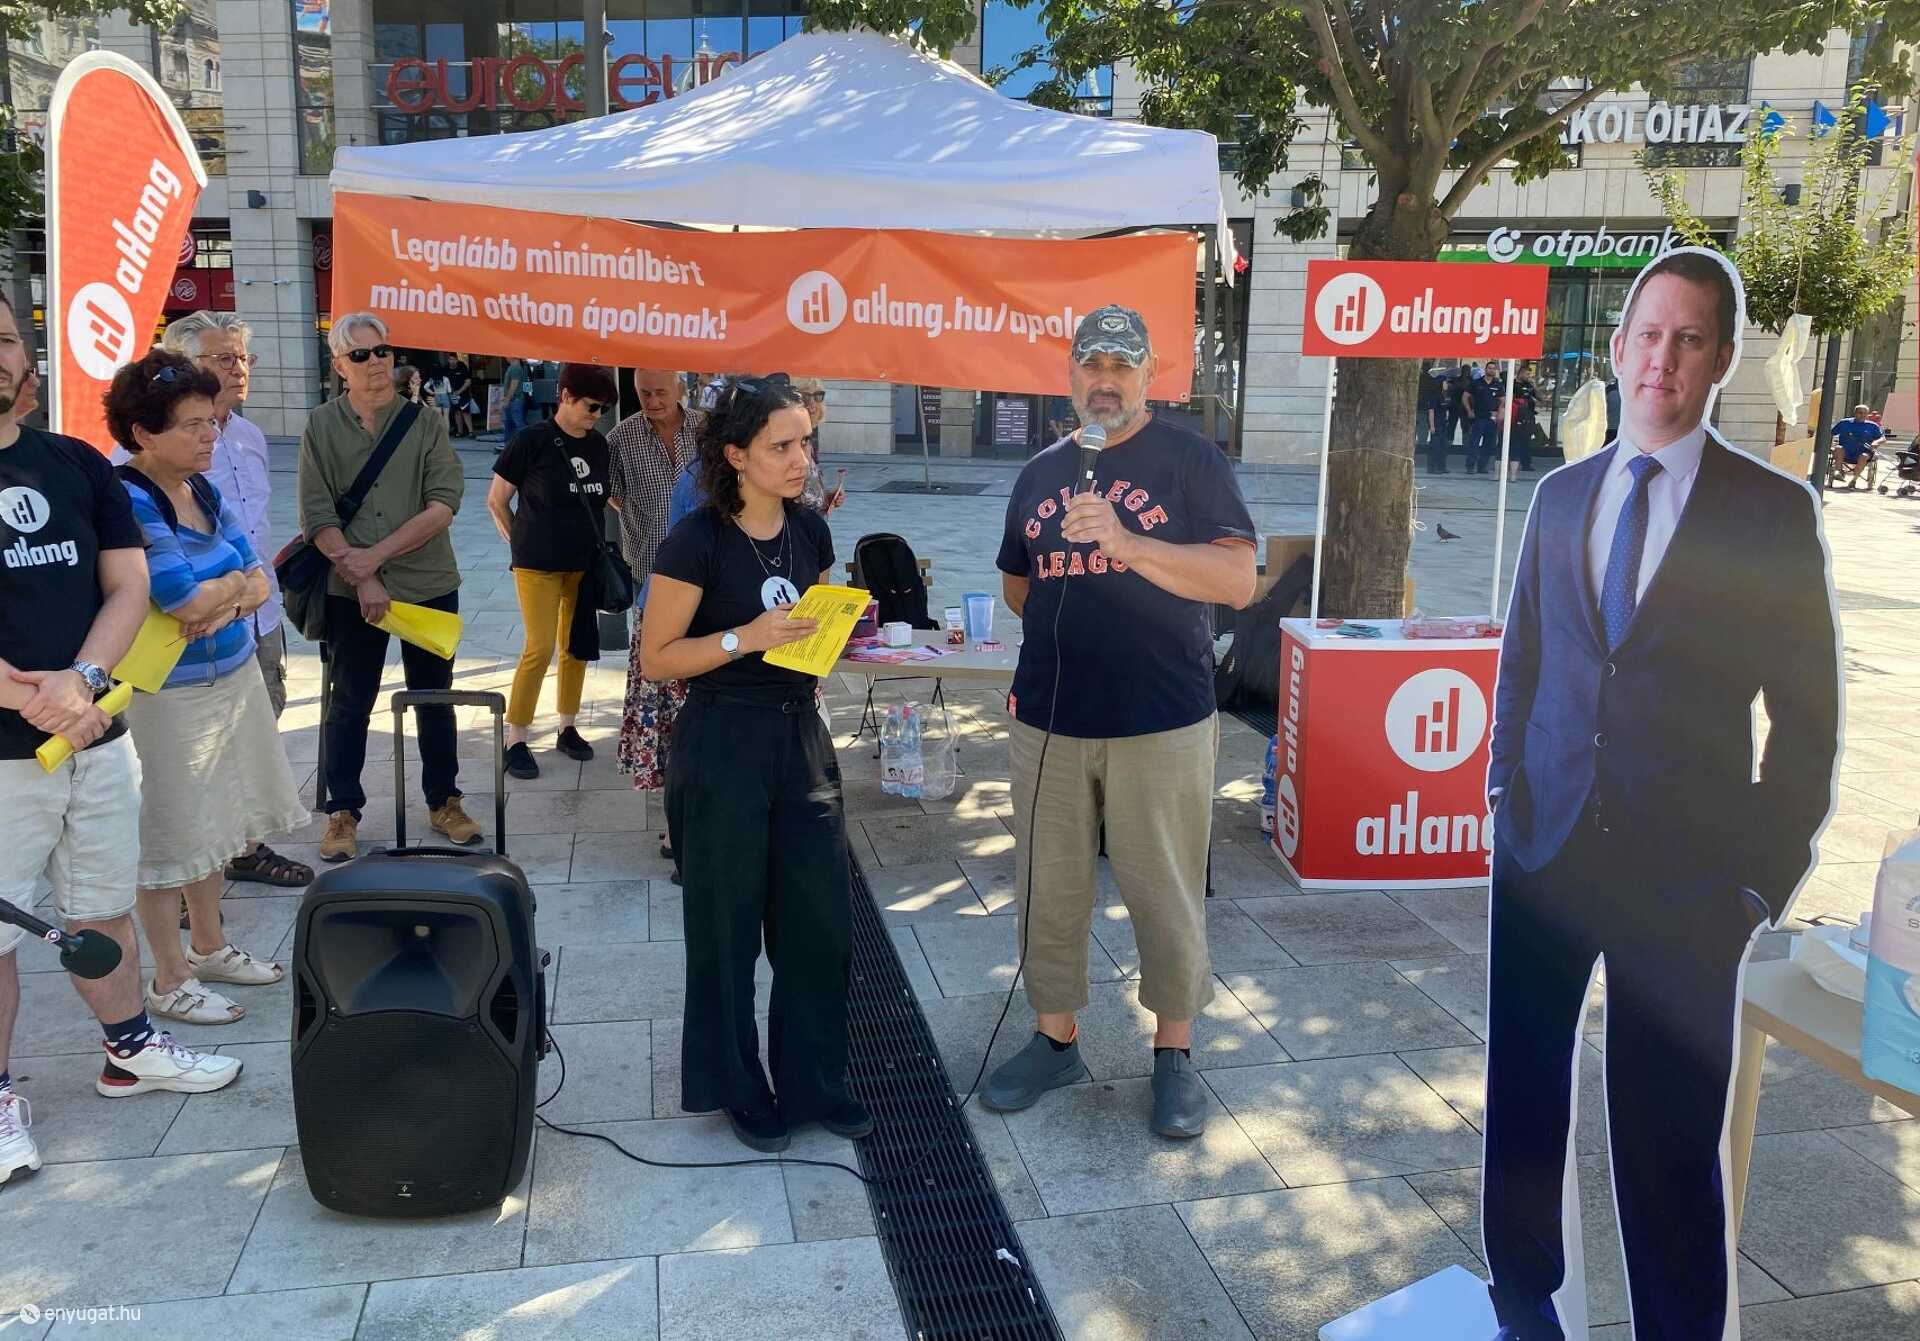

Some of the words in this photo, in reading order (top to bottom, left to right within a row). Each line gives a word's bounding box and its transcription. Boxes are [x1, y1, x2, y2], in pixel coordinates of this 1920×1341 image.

[112, 158, 182, 294] aHang
[1532, 225, 1681, 266] otpbank
[391, 228, 517, 272] Legalább
[526, 241, 705, 287] minimálbért
[370, 278, 478, 317] minden
[484, 292, 574, 328] otthon
[582, 297, 727, 340] ápolónak!
[1390, 288, 1538, 344] aHang.hu
[3, 536, 79, 568] aHang
[1282, 645, 1305, 774] aHang
